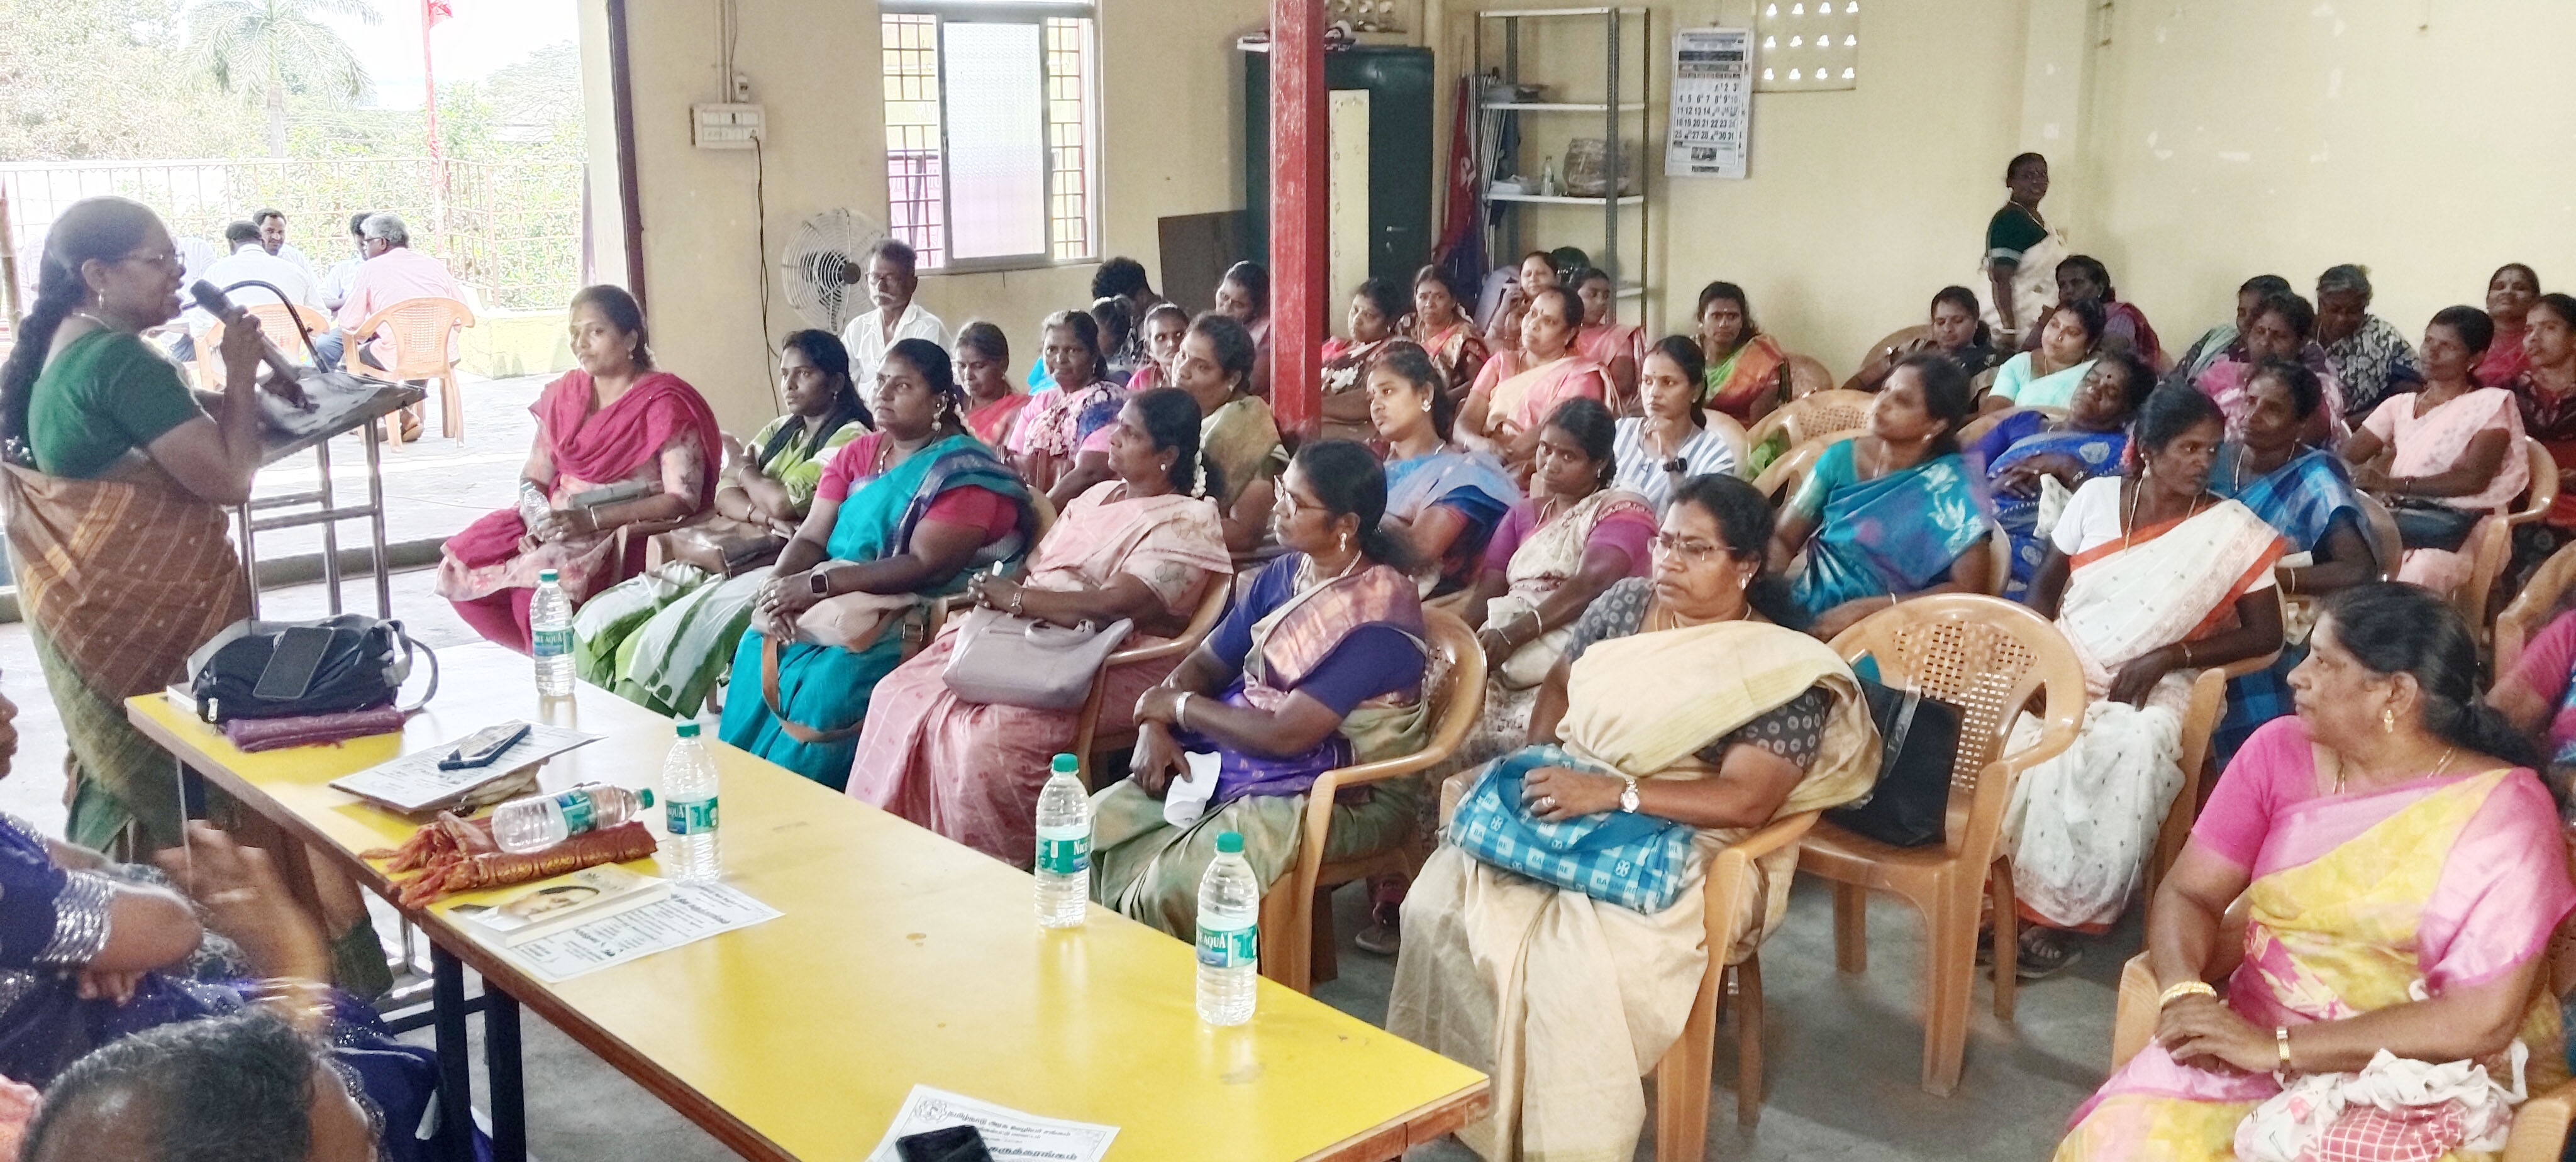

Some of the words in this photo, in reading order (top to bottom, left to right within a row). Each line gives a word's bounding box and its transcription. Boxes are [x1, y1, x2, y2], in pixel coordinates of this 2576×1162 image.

[1677, 106, 1684, 115] 11
[1685, 106, 1692, 115] 12
[1704, 106, 1711, 115] 14
[1693, 119, 1701, 127] 20
[1702, 119, 1709, 127] 21
[1711, 119, 1718, 128] 22
[1719, 119, 1727, 128] 23
[1692, 131, 1699, 139] 27
[1728, 131, 1734, 140] 31
[1203, 932, 1226, 949] AQUA
